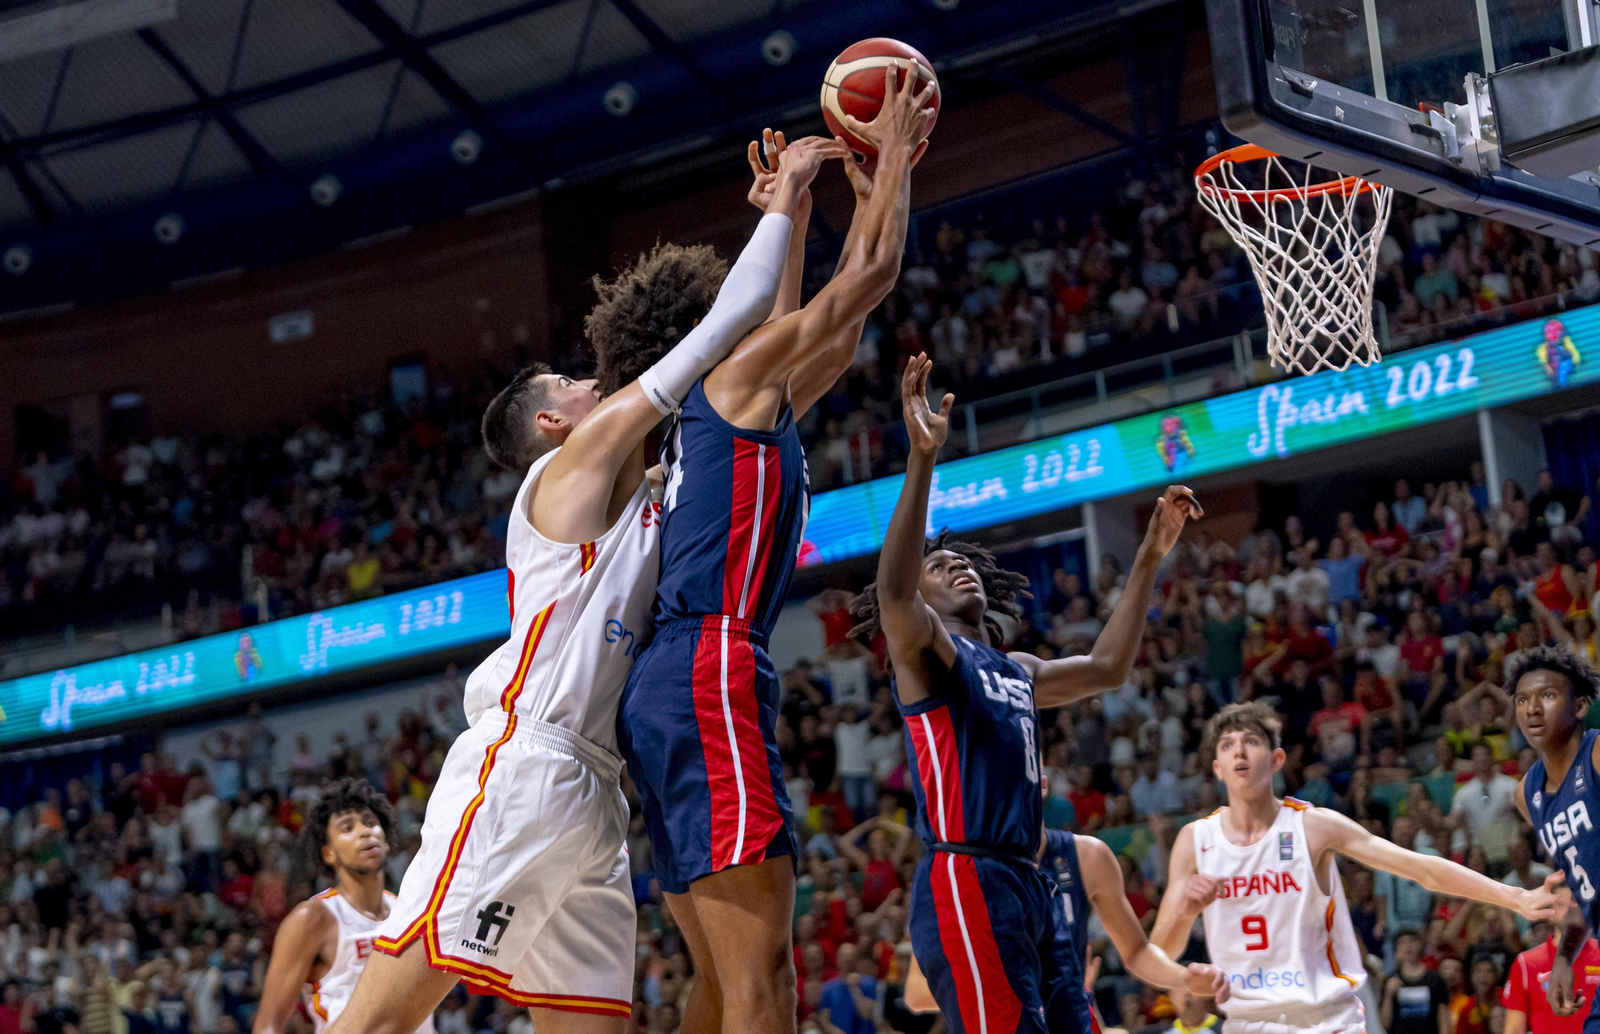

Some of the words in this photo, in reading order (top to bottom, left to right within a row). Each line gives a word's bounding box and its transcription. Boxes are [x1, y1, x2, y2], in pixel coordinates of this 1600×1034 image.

[1247, 385, 1368, 458] Spain
[1386, 348, 1479, 408] 2022
[926, 472, 1007, 535] pain
[1022, 439, 1104, 493] 2022
[1539, 800, 1593, 856] USA
[1216, 868, 1303, 898] SPAÑA
[1564, 845, 1596, 900] 5
[1241, 914, 1269, 951] 9
[1225, 966, 1305, 990] ndes
